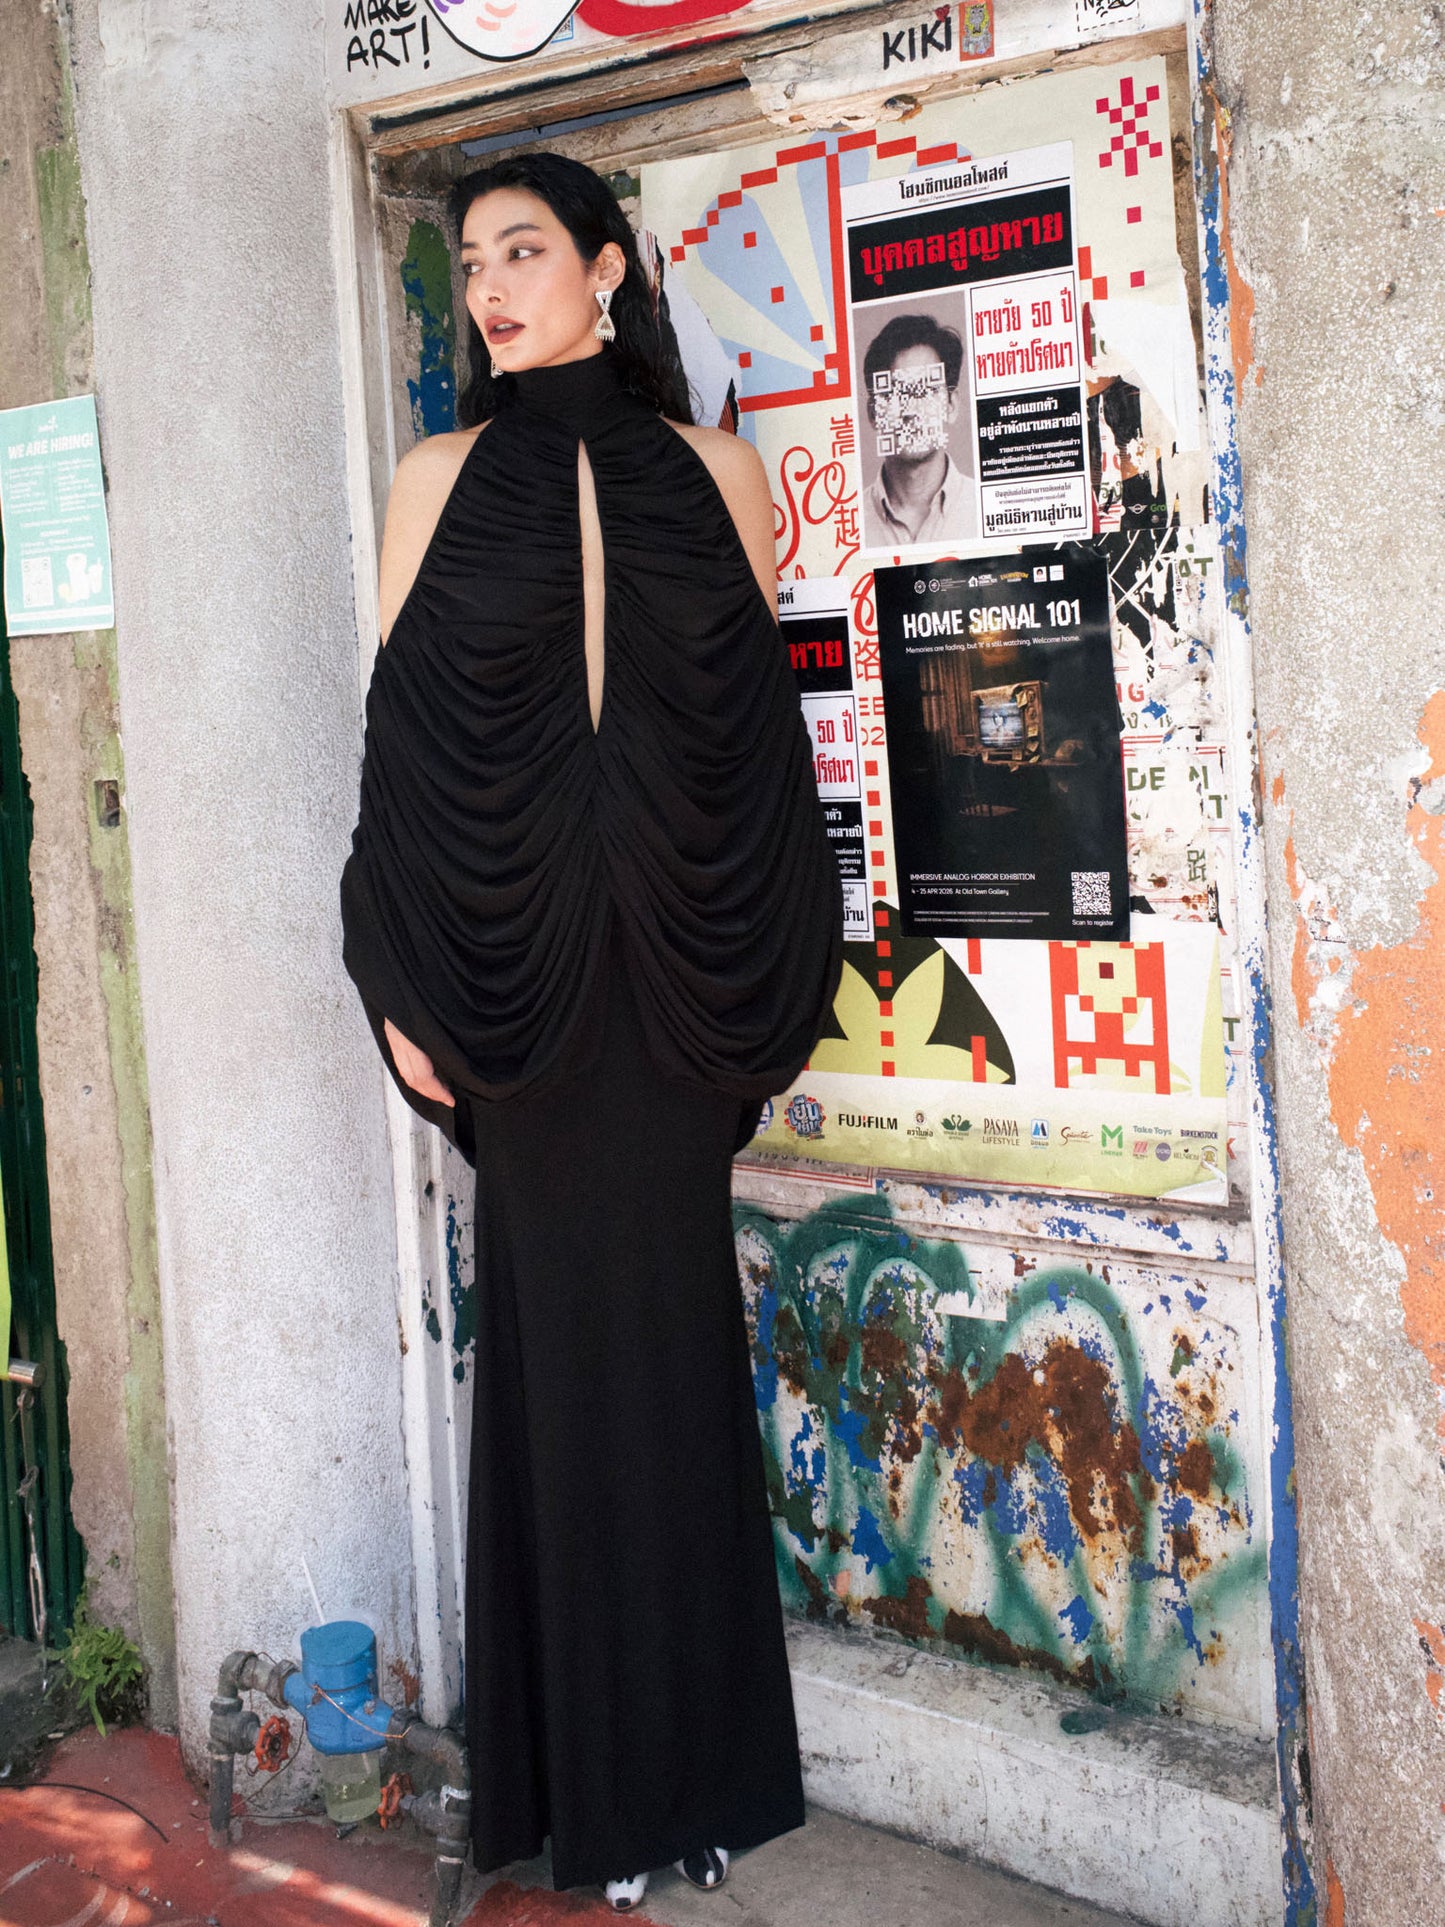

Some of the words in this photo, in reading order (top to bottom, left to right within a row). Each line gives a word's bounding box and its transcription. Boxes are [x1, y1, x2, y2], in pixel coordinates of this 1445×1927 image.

[344, 0, 417, 31] MAKE
[347, 16, 430, 72] ART!
[861, 212, 1064, 286] บุคคลสูญหาย
[975, 298, 1021, 337] ชายวัย
[1031, 300, 1052, 328] 50
[1060, 287, 1073, 324] ปี
[976, 338, 1073, 380] หายตัวปริศนา
[999, 396, 1059, 417] หลังแยกตัว
[980, 411, 1081, 440] อยู่ลำพังนานหลายปี
[8, 443, 25, 461] WE
[27, 438, 49, 457] ARE
[50, 431, 94, 453] HIRING!
[985, 503, 1083, 532] มูลนิธิหวนสู่บ้าน
[903, 609, 964, 639] HOME
[968, 602, 1042, 635] SIGNAL
[1046, 598, 1081, 628] 101
[1031, 636, 1061, 645] Welcome
[816, 719, 836, 744] 50
[842, 709, 855, 743] ปี
[910, 873, 943, 882] IMMERSIVE
[943, 873, 970, 881] ANALOG
[971, 873, 999, 881] HORROR
[1000, 872, 1036, 882] EXHIBITION
[988, 888, 1010, 896] Gallery
[1093, 919, 1114, 928] register
[838, 1113, 899, 1131] FUJIFILM
[983, 1117, 1020, 1137] PASAYA
[1154, 1126, 1172, 1137] Toys
[982, 1136, 1022, 1147] LIFESTYLE
